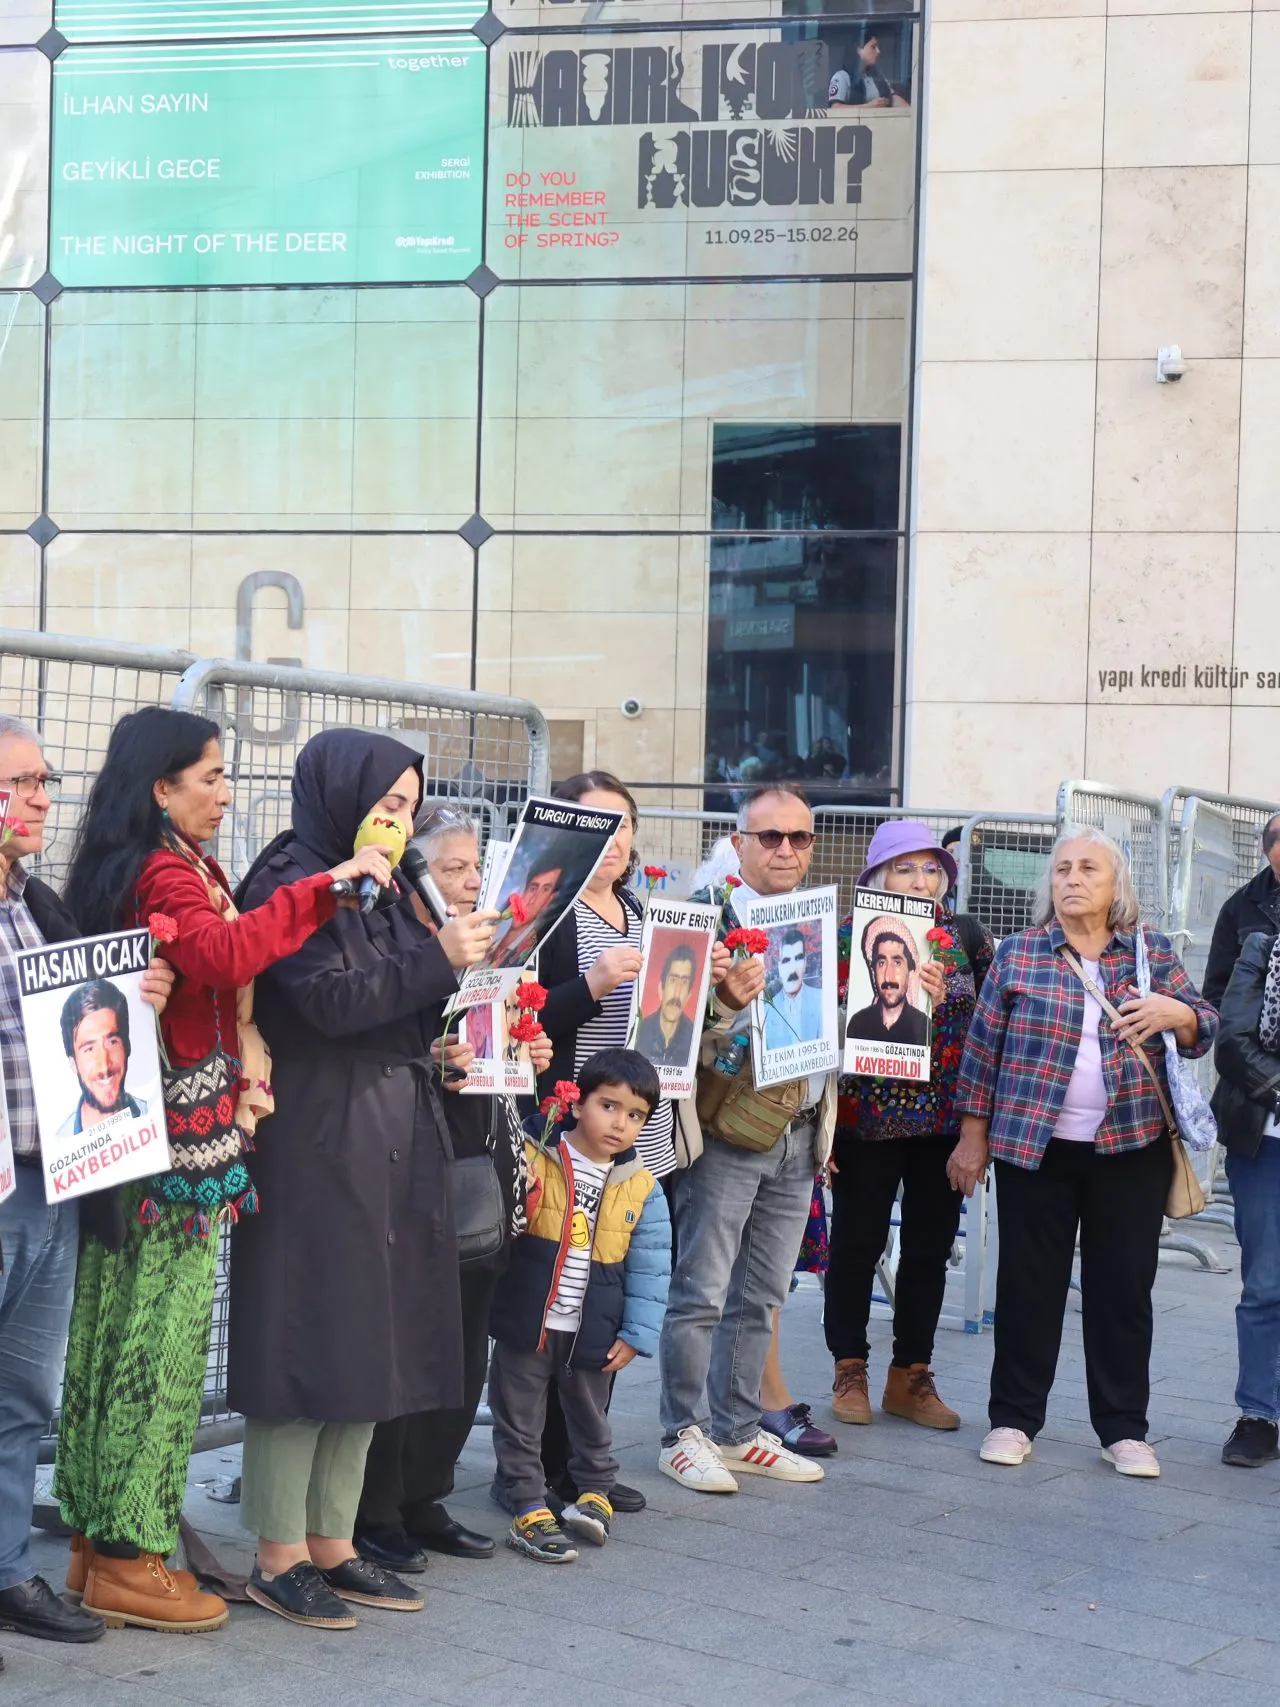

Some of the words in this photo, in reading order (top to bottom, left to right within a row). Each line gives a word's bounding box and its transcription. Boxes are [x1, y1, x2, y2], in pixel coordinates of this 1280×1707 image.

[388, 54, 470, 71] together
[63, 92, 133, 116] İLHAN
[140, 93, 209, 113] SAYIN
[62, 155, 151, 181] GEYİKLİ
[157, 158, 220, 180] GECE
[441, 156, 471, 167] SERGİ
[415, 169, 471, 180] EXHIBITION
[505, 173, 531, 187] DO
[540, 172, 576, 186] YOU
[505, 191, 606, 207] REMEMBER
[506, 212, 541, 227] THE
[548, 211, 609, 226] SCENT
[60, 235, 108, 256] THE
[112, 235, 187, 255] NIGHT
[193, 234, 225, 253] OF
[231, 234, 281, 253] THE
[285, 232, 347, 252] DEER
[504, 232, 530, 248] OF
[537, 232, 620, 247] SPRING?
[1099, 669, 1133, 692] yapı
[1141, 664, 1186, 688] kredi
[1194, 664, 1249, 689] kültür
[1256, 671, 1280, 689] sa
[533, 806, 575, 827] TURGUT
[575, 814, 613, 831] YENİSOY
[750, 897, 795, 926] ABDULKERİM
[796, 895, 834, 919] YURTSEVEN
[857, 892, 901, 913] KEREVAN
[903, 897, 933, 917] İRMEZ
[649, 907, 687, 926] YUSUF
[688, 912, 717, 932] ERİŞTİ
[23, 949, 88, 992] HASAN
[92, 936, 146, 974] OCAK
[774, 1049, 795, 1063] EKİM
[885, 1044, 925, 1058] GÖZALTINDA
[855, 1055, 921, 1078] KAYBEDİLDİ
[53, 1119, 158, 1195] KAYBEDİLDİ
